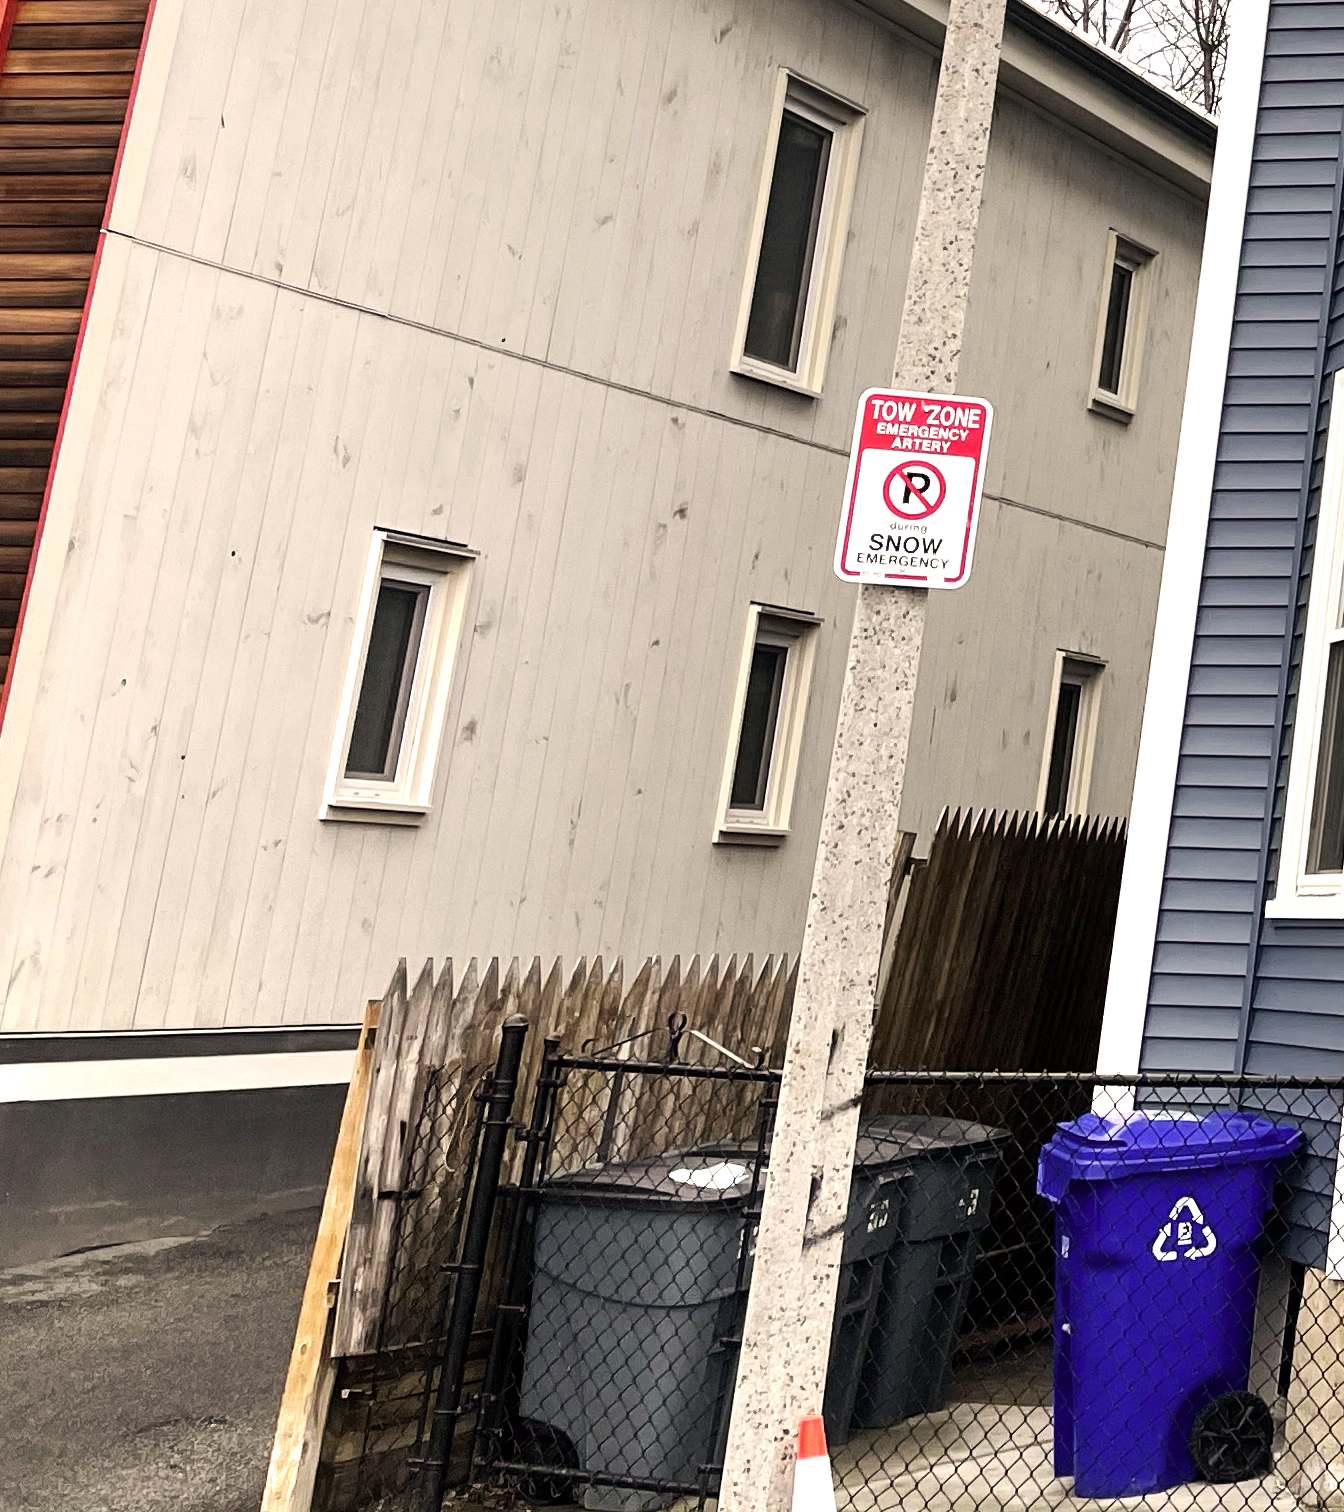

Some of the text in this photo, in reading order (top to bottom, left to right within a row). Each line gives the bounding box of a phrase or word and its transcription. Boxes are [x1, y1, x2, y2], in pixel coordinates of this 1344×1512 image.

[871, 399, 981, 429] TOW ZONE
[876, 421, 969, 442] EMERGENCY
[891, 436, 951, 453] ARTERY
[889, 521, 928, 534] during
[868, 533, 943, 555] SNOW
[856, 552, 949, 569] EMERGENCY
